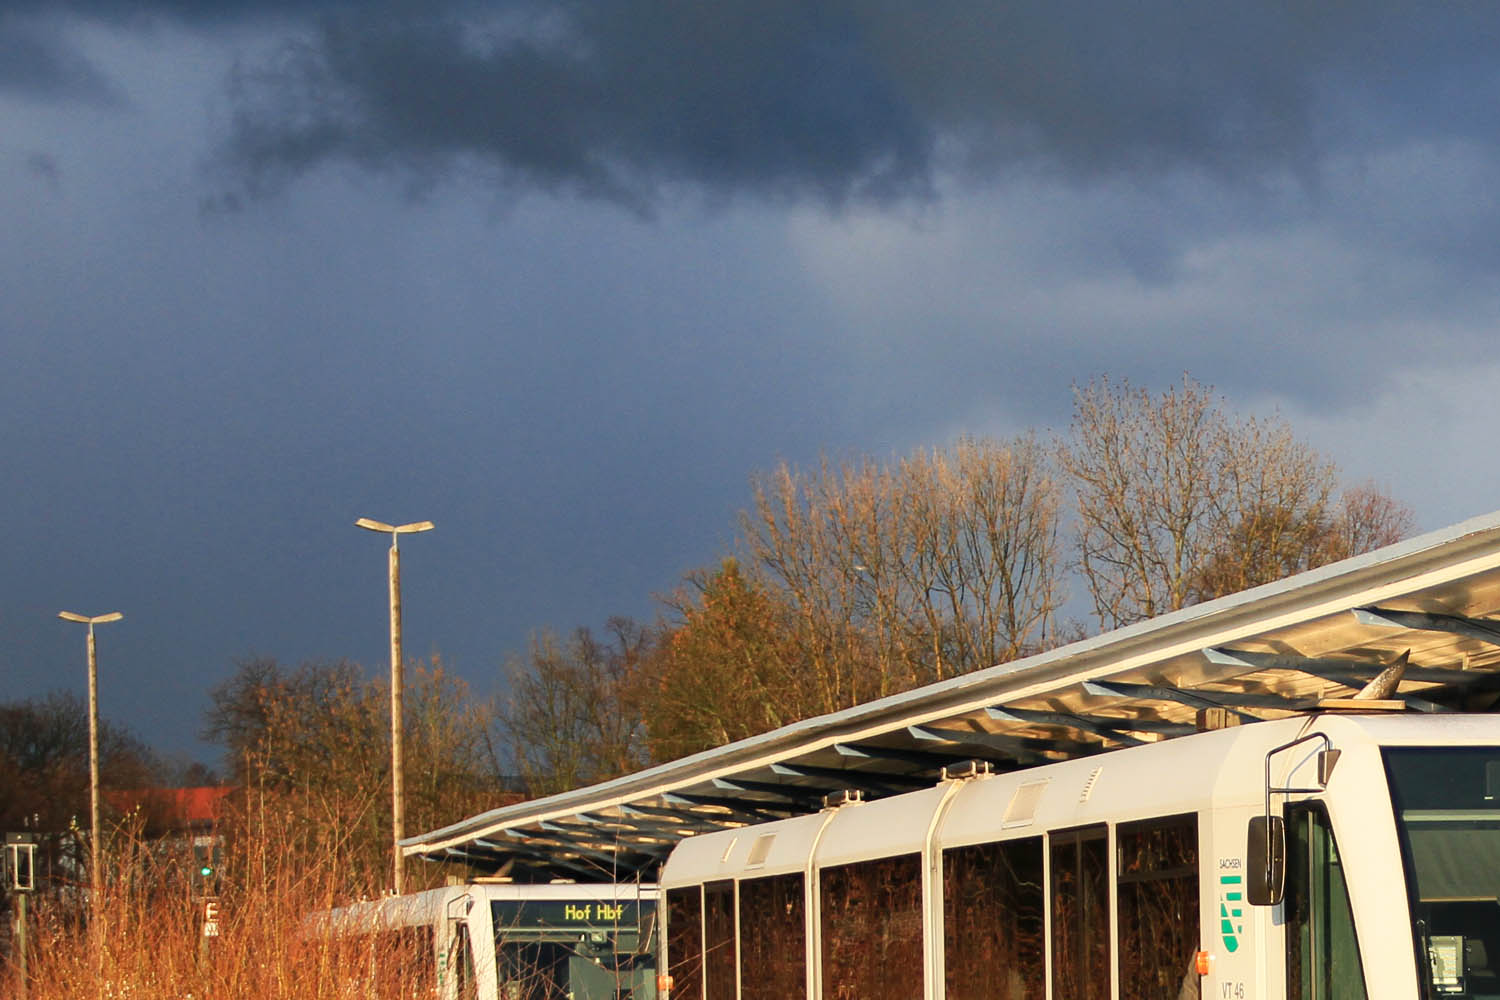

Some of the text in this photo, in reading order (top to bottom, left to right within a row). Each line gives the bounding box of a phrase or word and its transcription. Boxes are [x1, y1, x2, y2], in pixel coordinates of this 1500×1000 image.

[565, 904, 623, 920] Hof Hbf
[1222, 982, 1245, 1000] VT 46
